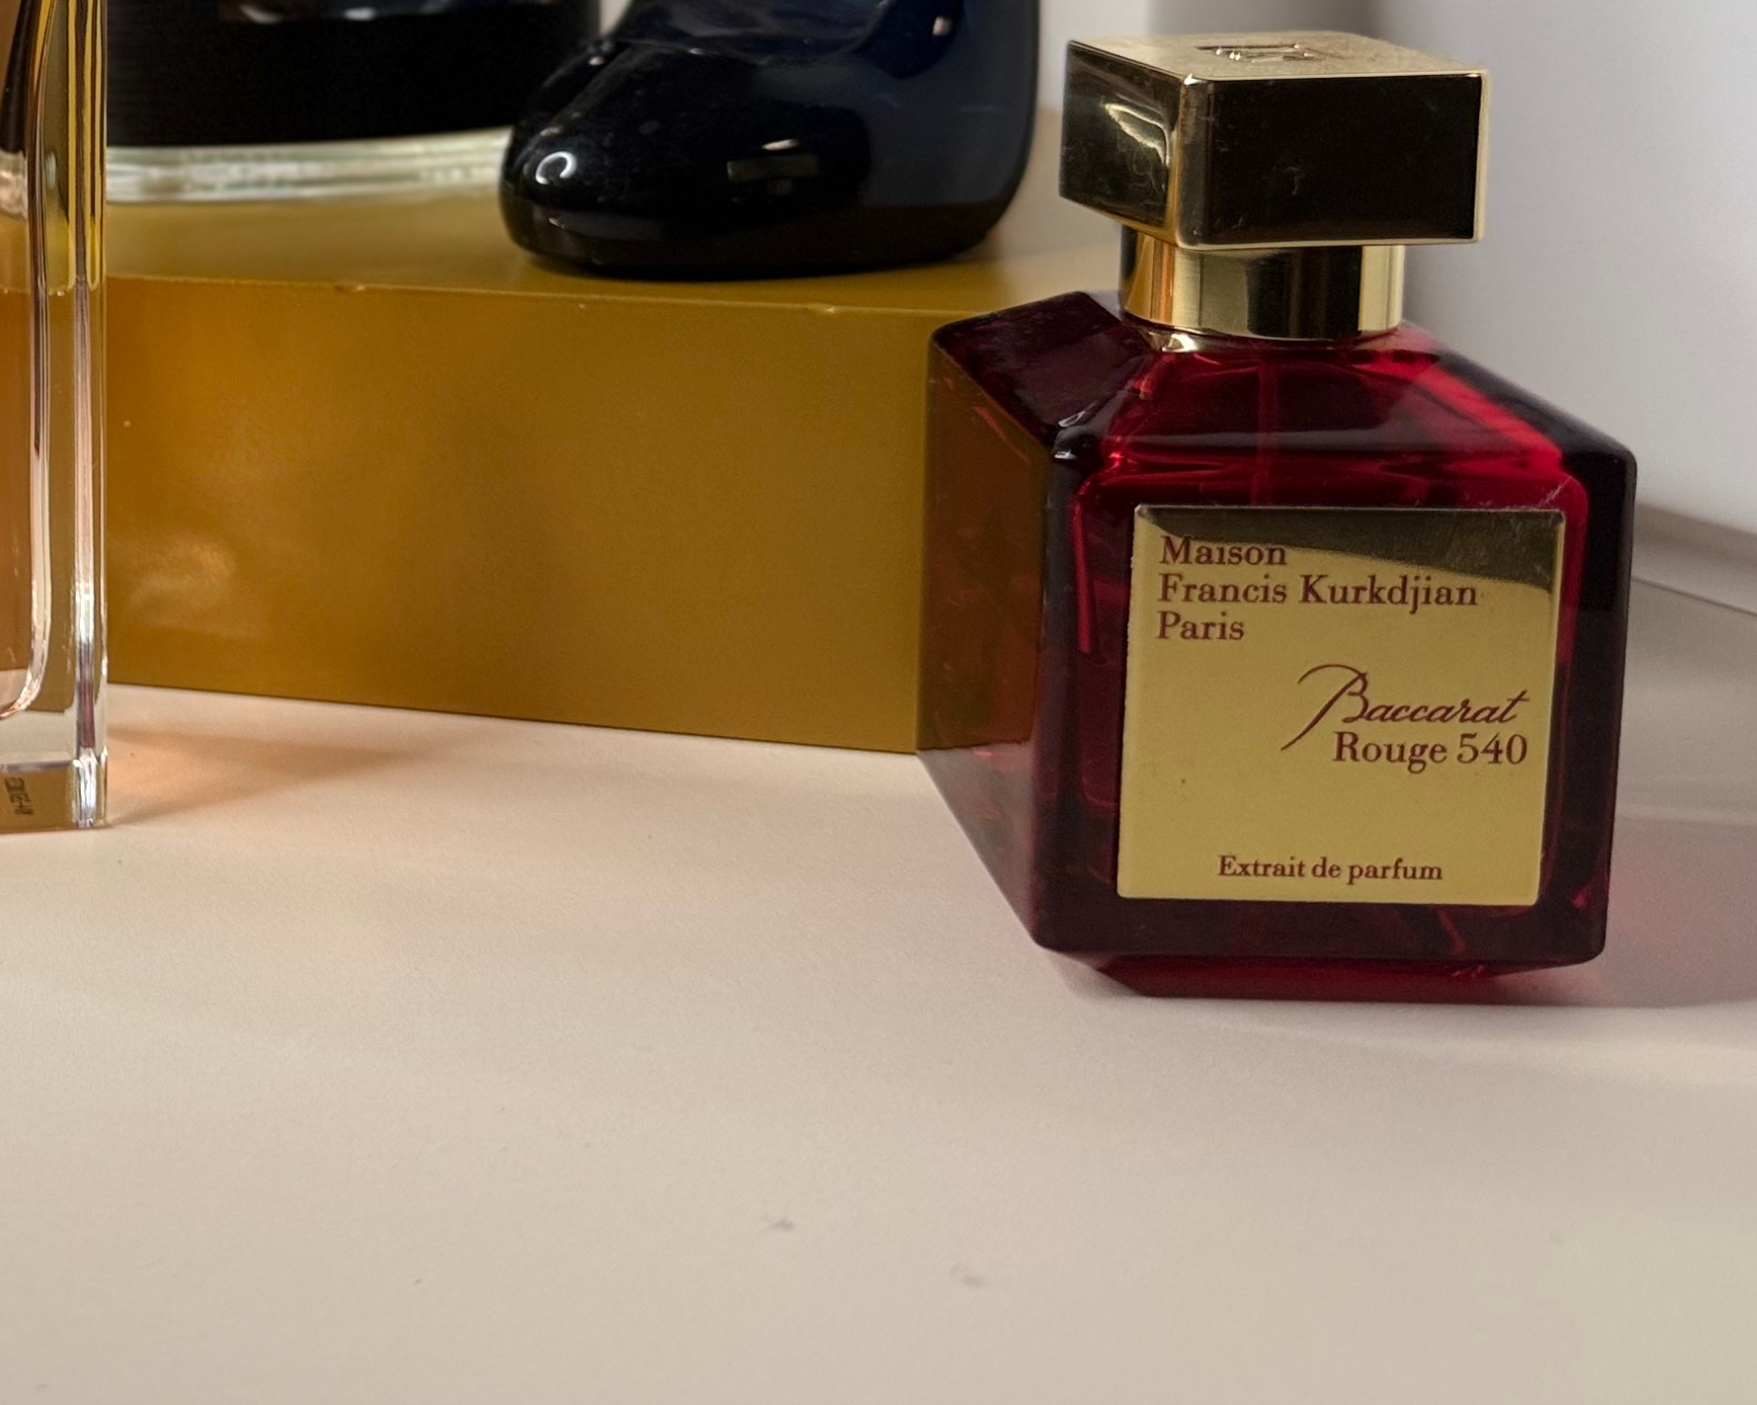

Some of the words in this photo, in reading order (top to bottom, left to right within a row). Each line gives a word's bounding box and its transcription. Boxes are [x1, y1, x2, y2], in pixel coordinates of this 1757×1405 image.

[1158, 534, 1288, 567] Maison
[1157, 573, 1288, 605] Francis
[1297, 574, 1479, 616] Kurkdjian
[1156, 610, 1245, 641] Paris
[1280, 663, 1531, 752] Baccarat
[1330, 730, 1449, 776] Rouge
[1456, 732, 1529, 766] 540
[1216, 854, 1307, 879] Extrait
[1310, 856, 1342, 880] de
[1347, 858, 1444, 887] parfum
